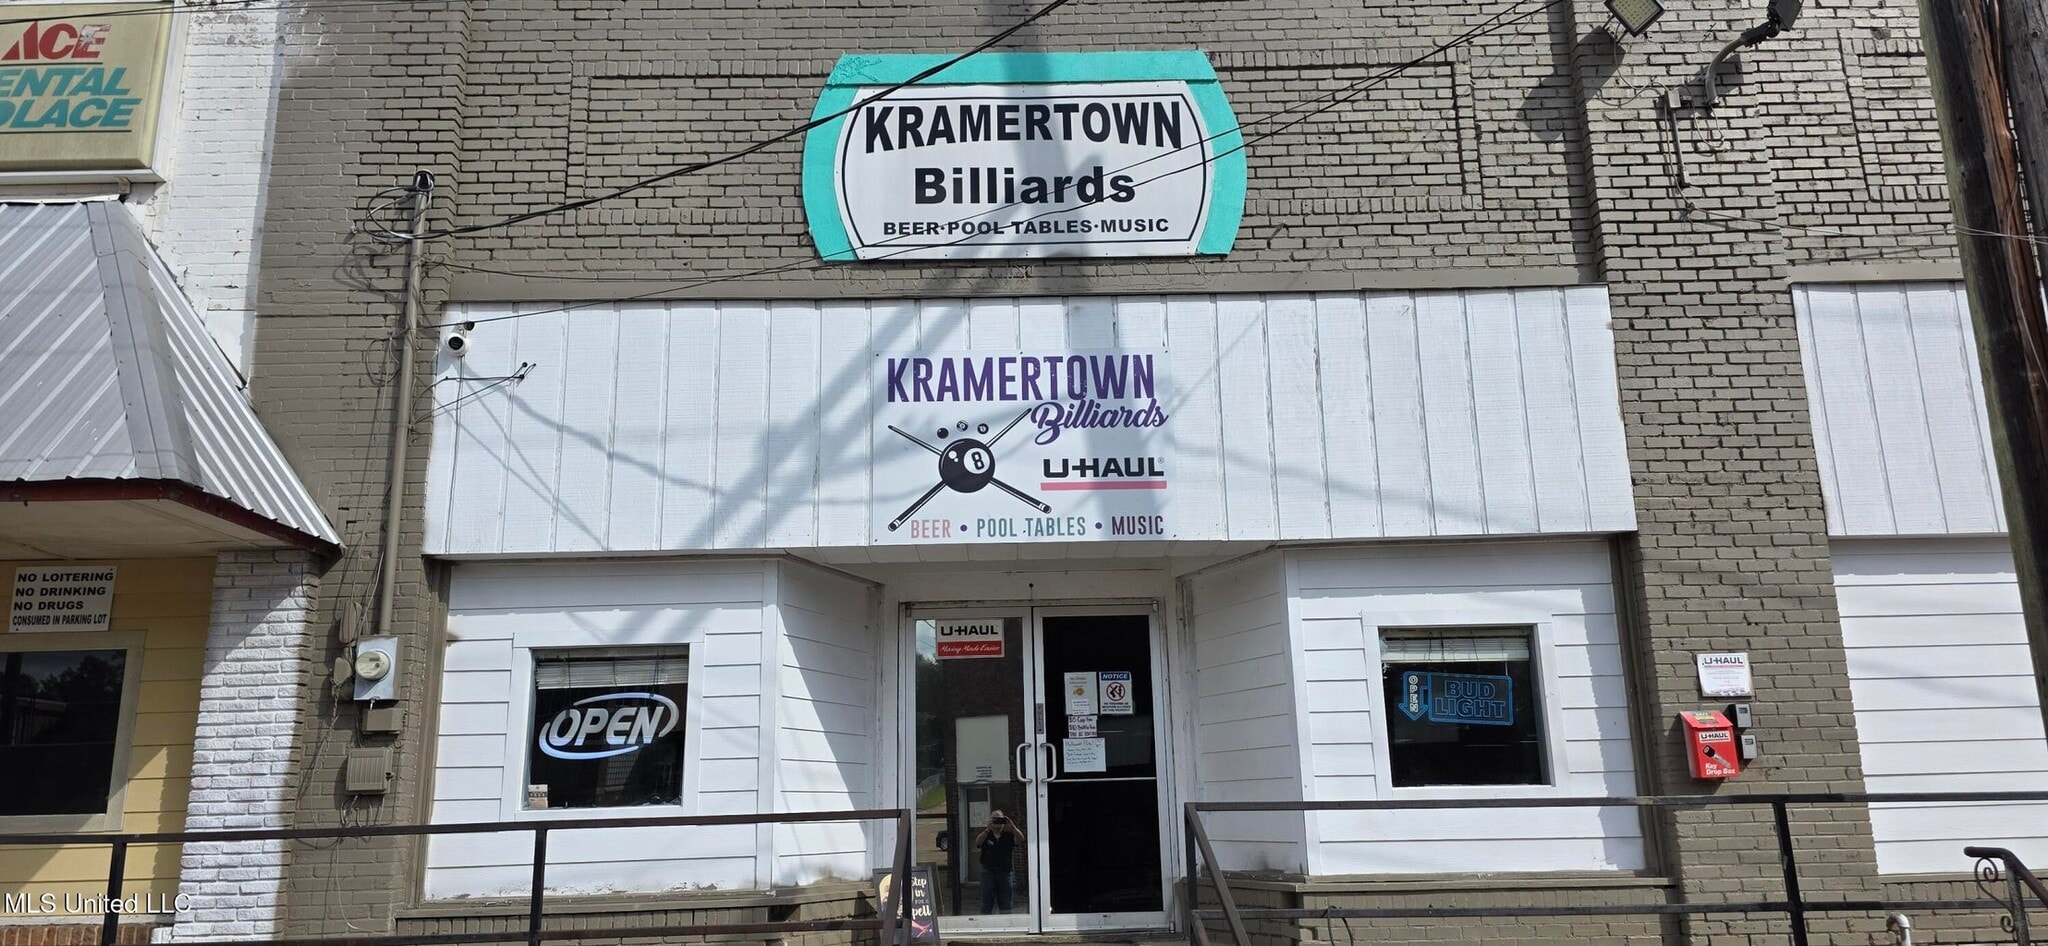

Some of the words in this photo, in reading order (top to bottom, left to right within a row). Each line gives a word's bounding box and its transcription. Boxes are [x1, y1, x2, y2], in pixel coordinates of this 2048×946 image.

[1, 20, 111, 60] ACE
[0, 67, 130, 97] ENTAL
[865, 101, 1182, 154] KRAMERTOWN
[914, 166, 1136, 205] Billiards
[887, 354, 1155, 403] KRAMERTOWN
[1030, 398, 1169, 446] Billiards
[1043, 457, 1164, 478] U-HAUL
[911, 519, 951, 539] BEER
[977, 517, 1017, 538] POOL
[1025, 516, 1087, 537] TABLES
[1111, 515, 1164, 536] MUSIC
[17, 573, 37, 583] NO
[42, 572, 114, 582] LOITERING
[15, 587, 35, 597] NO
[39, 586, 106, 596] DRINKING
[13, 601, 33, 611] NO
[38, 601, 84, 610] DRUGS
[12, 615, 50, 626] CONSUMED
[52, 615, 60, 625] IN
[61, 614, 92, 625] PARKING
[93, 613, 107, 624] LOT
[941, 625, 999, 636] U-HAUL
[1408, 675, 1419, 713] OPEN
[1444, 680, 1496, 700] BUD
[1434, 697, 1506, 719] LIGHT
[548, 706, 665, 747] OPEN
[1705, 762, 1718, 771] Key
[1706, 768, 1722, 776] Drop
[912, 905, 932, 920] pell
